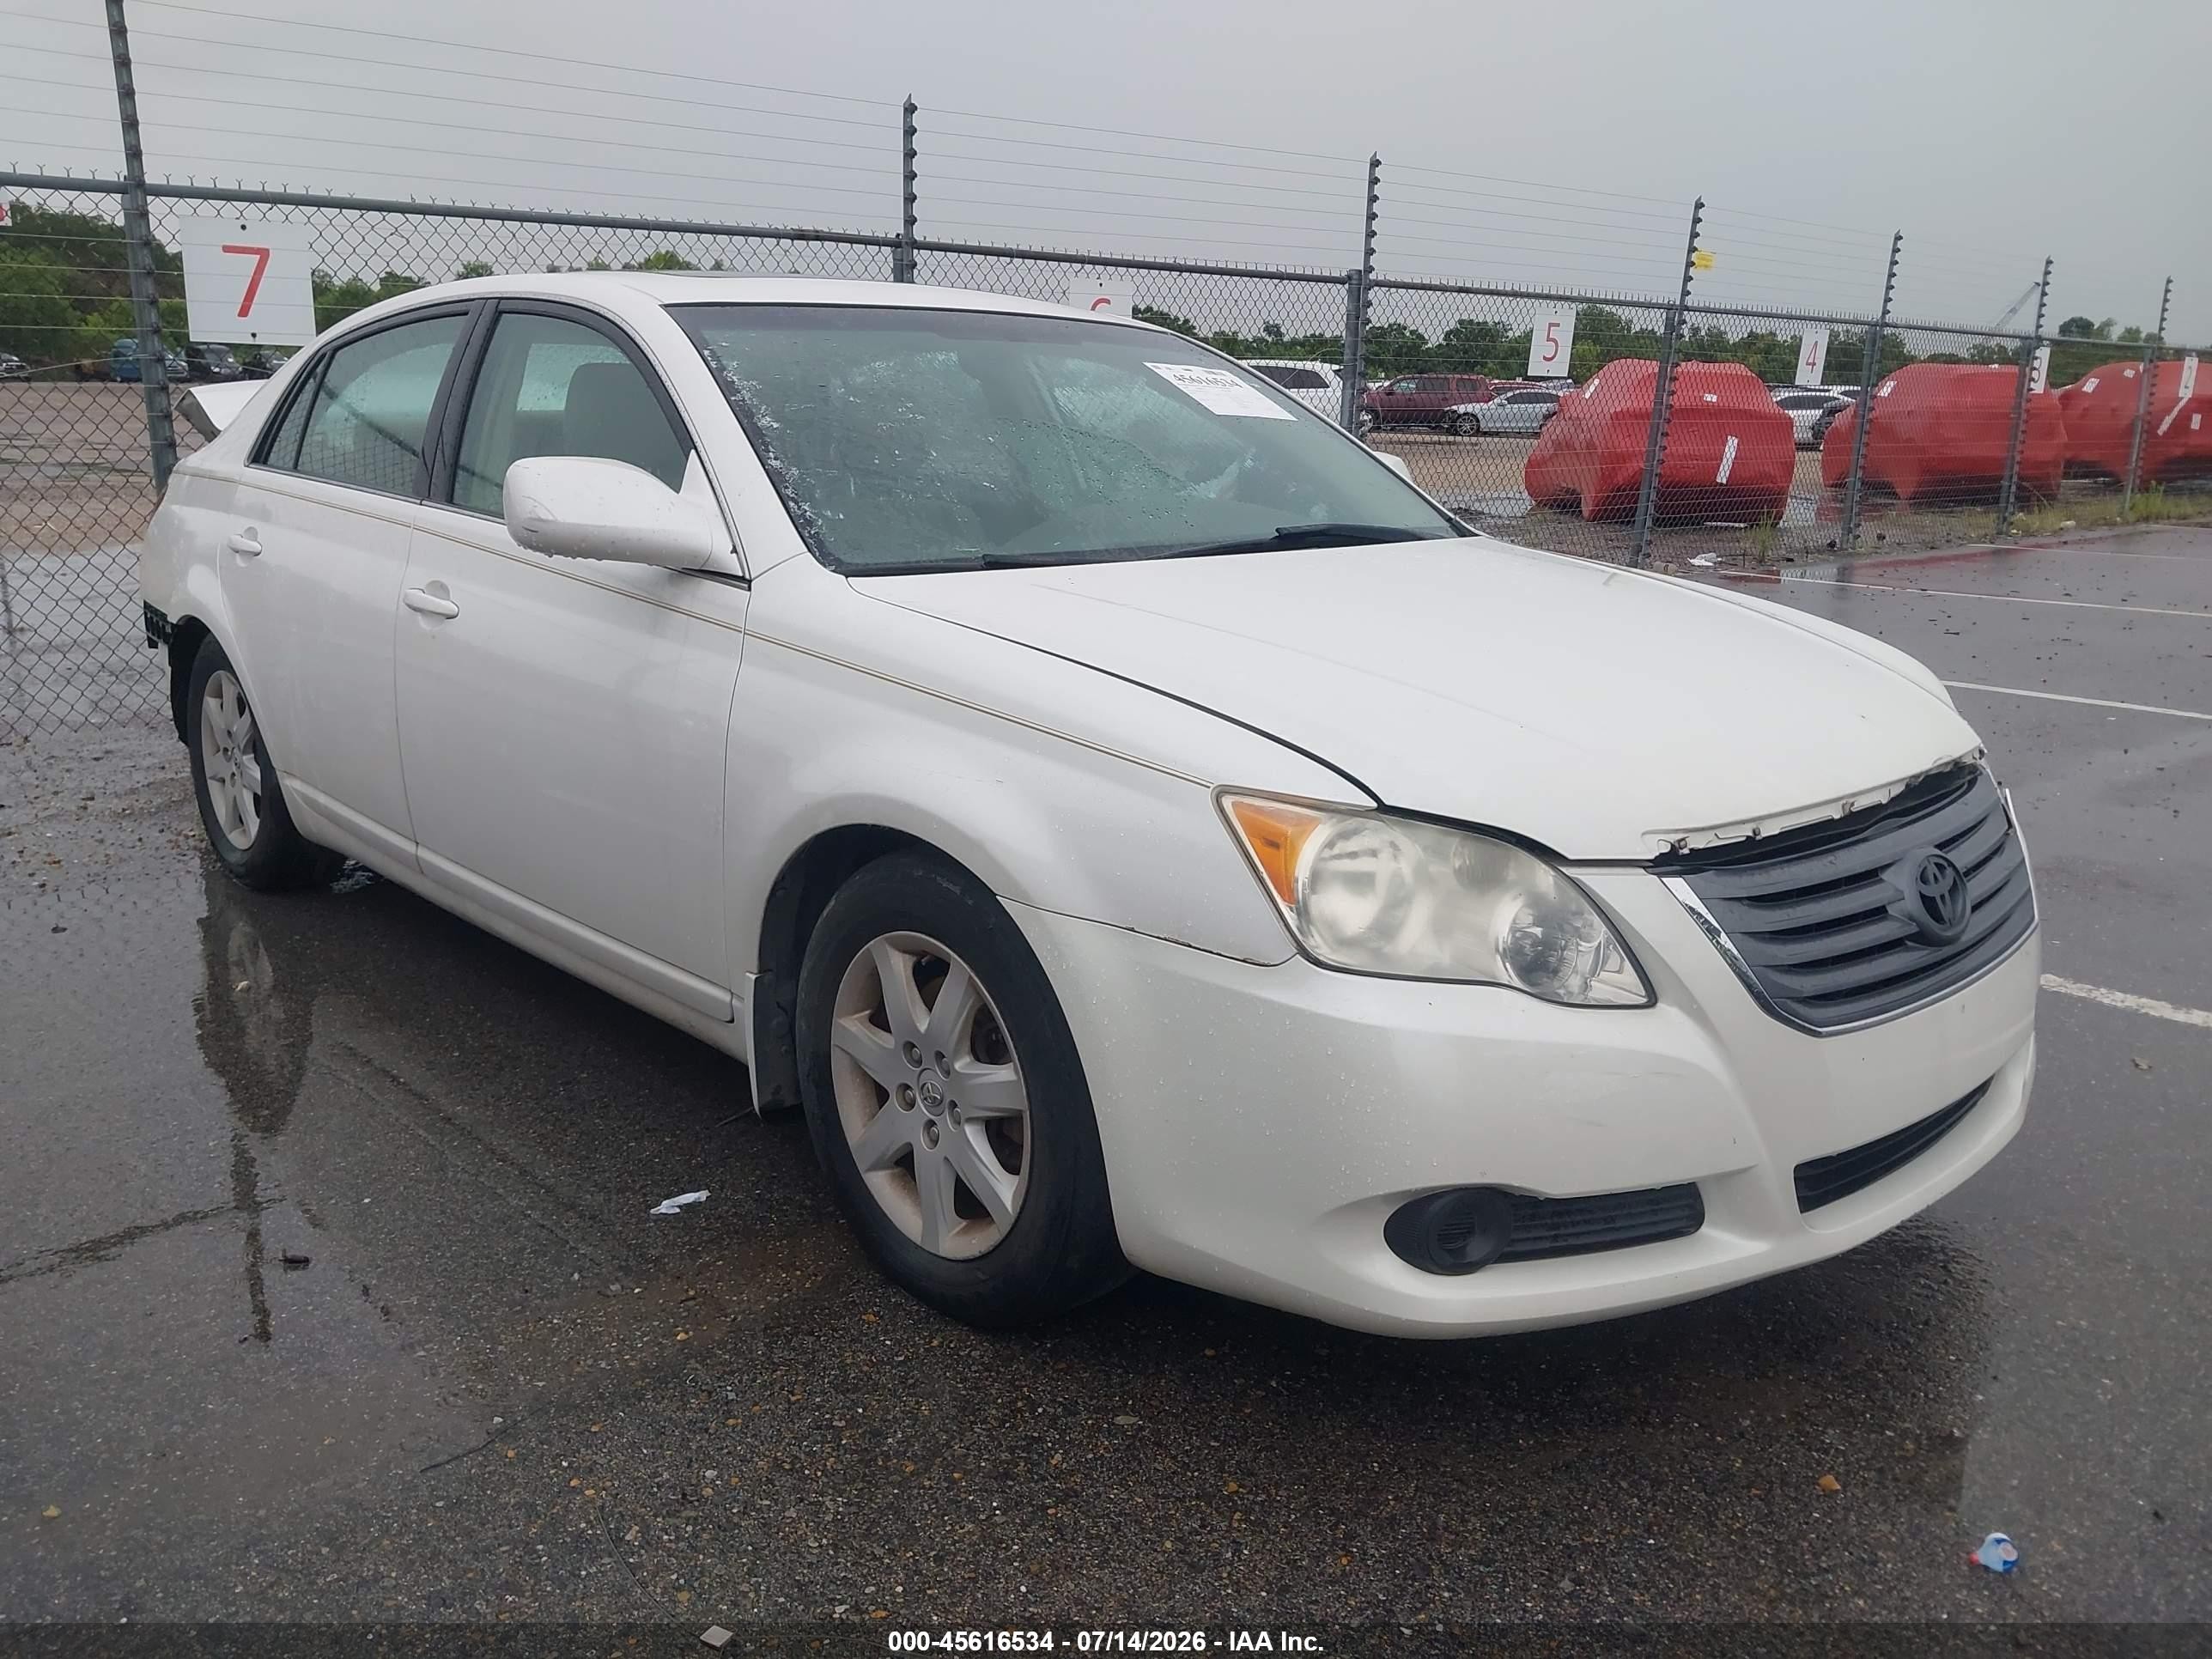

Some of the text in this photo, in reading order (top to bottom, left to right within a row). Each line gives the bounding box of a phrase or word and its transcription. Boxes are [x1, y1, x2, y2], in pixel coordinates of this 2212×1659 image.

[222, 245, 270, 318] 7
[1543, 322, 1560, 362] 5
[1806, 341, 1819, 374] 4
